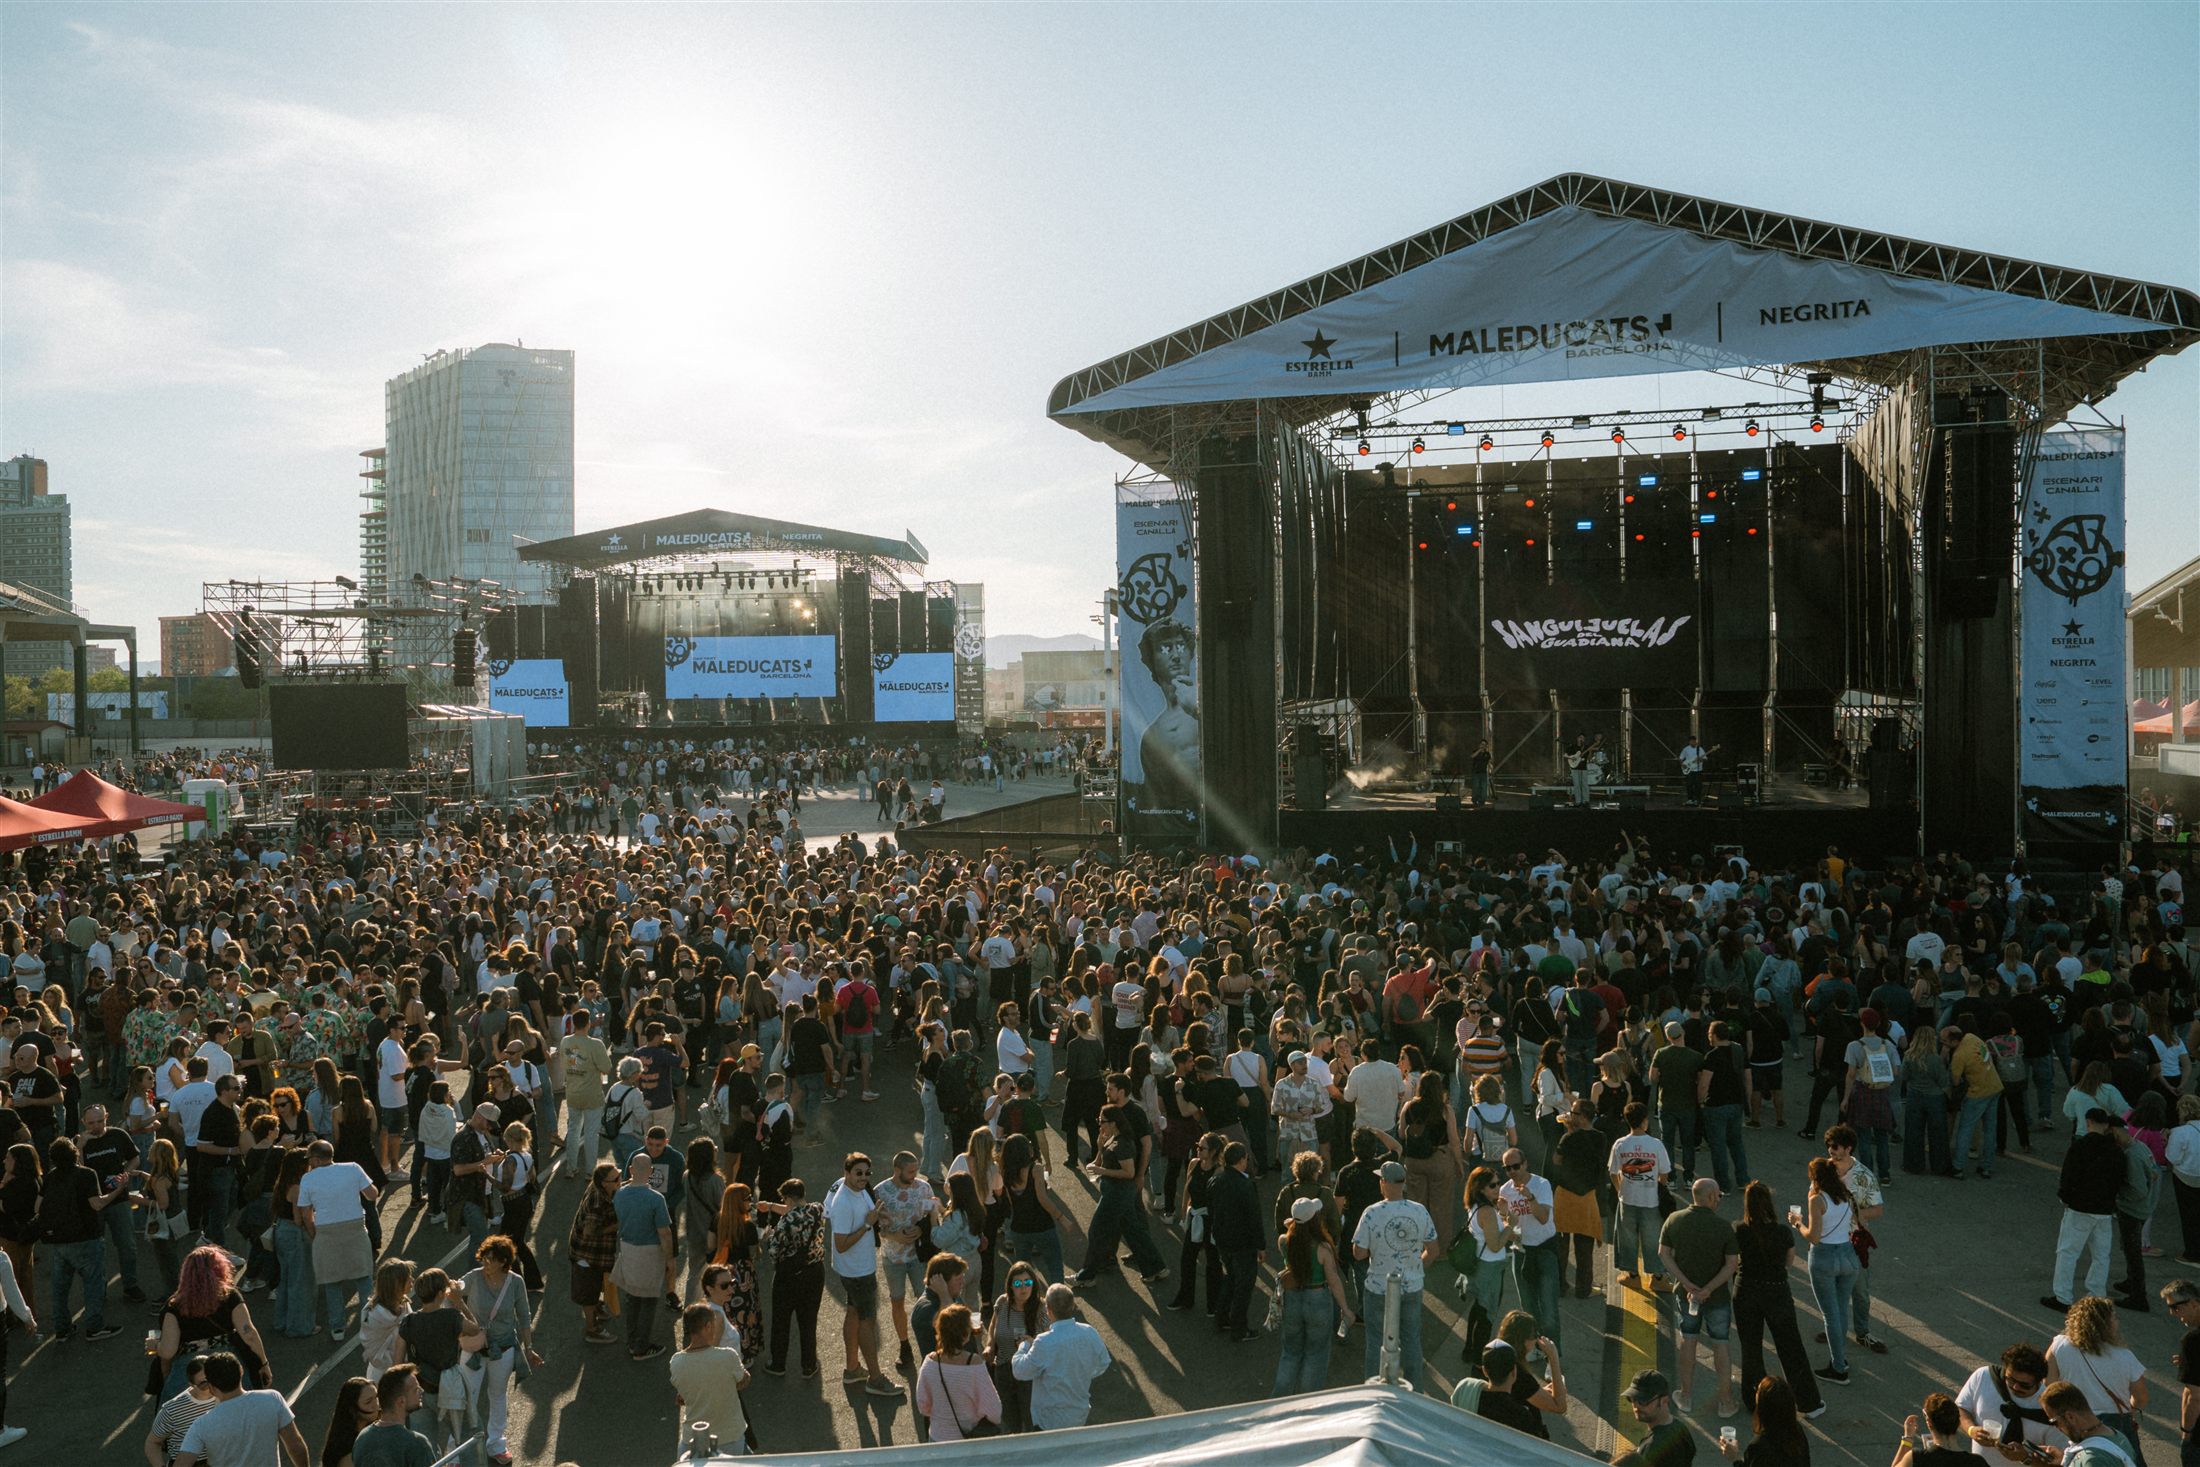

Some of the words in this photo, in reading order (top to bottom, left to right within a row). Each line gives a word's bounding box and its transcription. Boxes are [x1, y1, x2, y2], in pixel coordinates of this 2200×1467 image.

[1760, 299, 1871, 325] NEGRITA
[1429, 315, 1650, 357] MALEDUCATS
[1565, 341, 1673, 359] BARCELONA
[1285, 360, 1354, 372] ESTRELLA
[2043, 476, 2103, 485] ESCENARI
[2045, 486, 2101, 495] CANALLA
[656, 532, 742, 546] MALEDUCATS
[1491, 615, 1691, 649] SANGUIJUELAS
[1540, 636, 1640, 649] GUADIANA
[2051, 637, 2095, 645] ESTRELLA
[692, 659, 801, 674] MALEDUCATS
[2050, 658, 2097, 667] NEGRITA
[494, 688, 558, 697] MALEDUCATS
[878, 681, 943, 691] MALEDUCATS
[38, 831, 64, 842] ESTRELLA
[64, 829, 82, 837] DAMM
